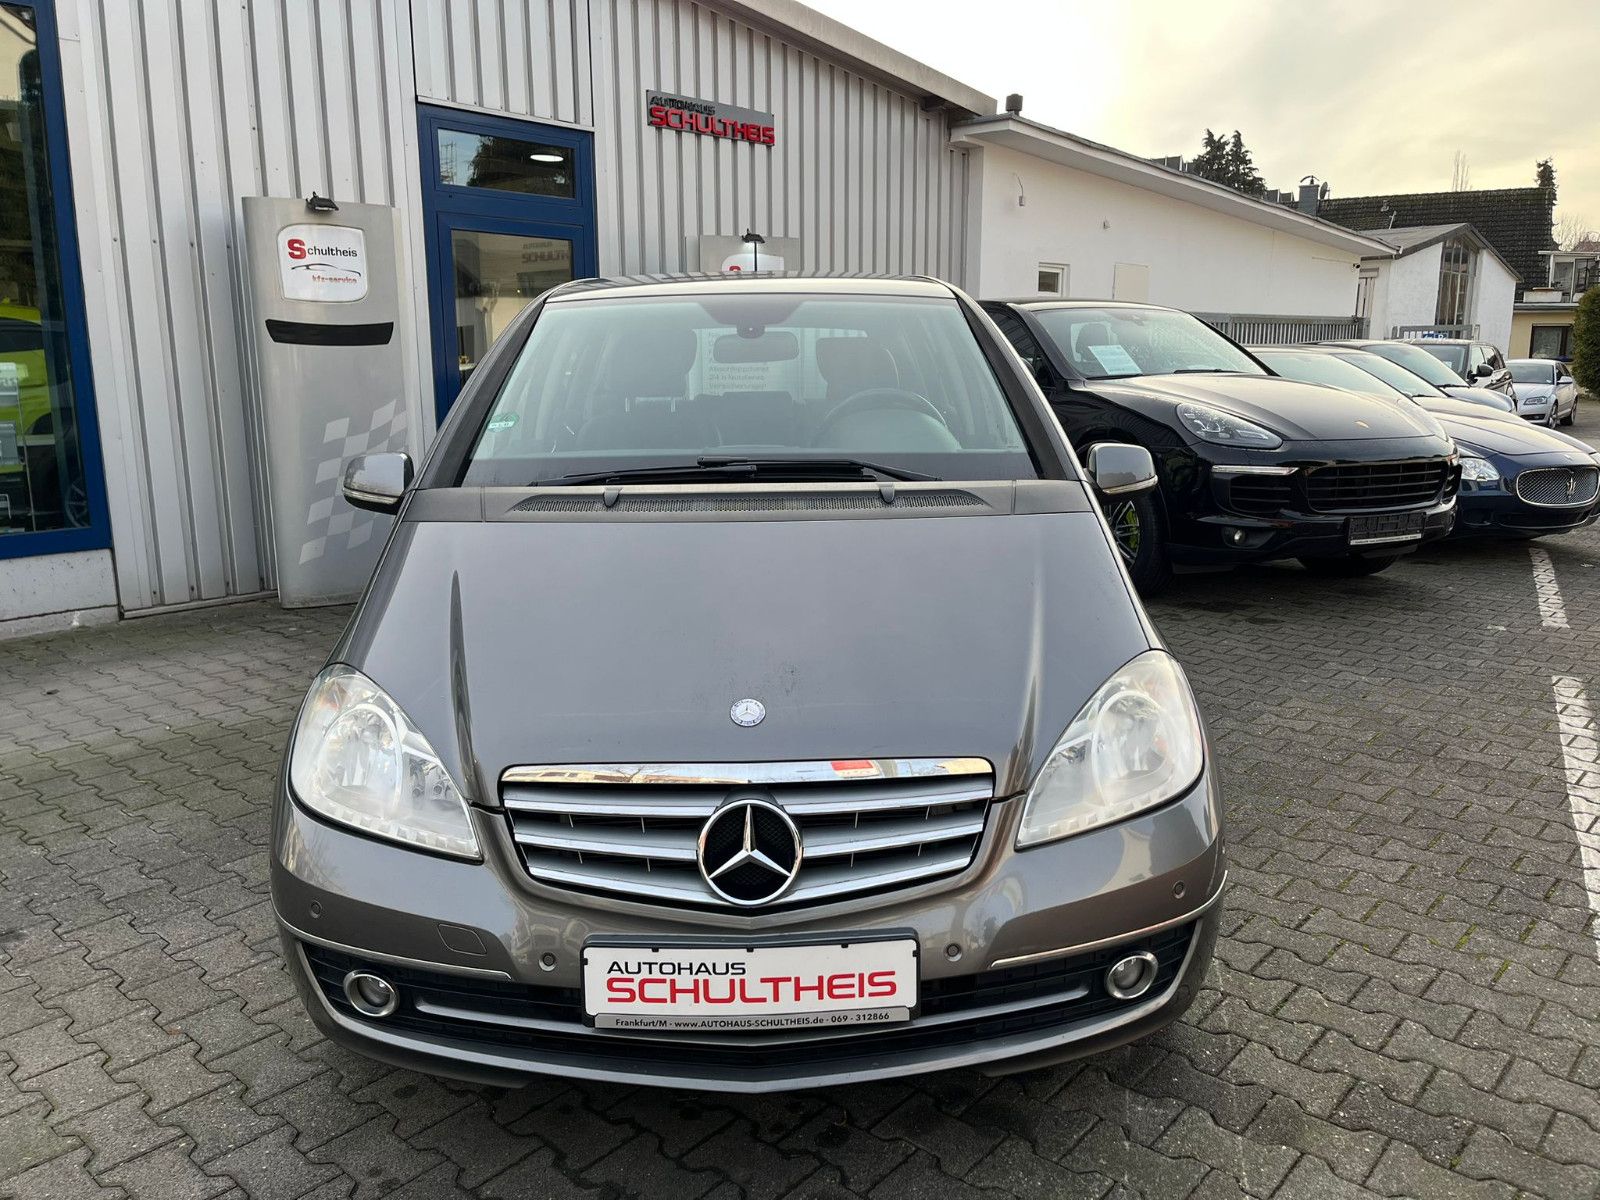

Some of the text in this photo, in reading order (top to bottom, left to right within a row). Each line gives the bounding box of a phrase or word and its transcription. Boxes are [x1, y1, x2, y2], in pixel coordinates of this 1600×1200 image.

[650, 96, 715, 115] AUTOHAUS
[649, 105, 775, 144] SCHULTHEIS
[287, 238, 358, 260] Schultheis
[607, 960, 747, 976] AUTOHAUS
[606, 971, 897, 1003] SCHULTHEIS
[615, 1018, 668, 1028] Frankfurt/M
[674, 1016, 824, 1028] www.AUTOHAUS-SCHULTHEIS.de
[830, 1014, 848, 1023] 069
[855, 1012, 890, 1022] 312866
